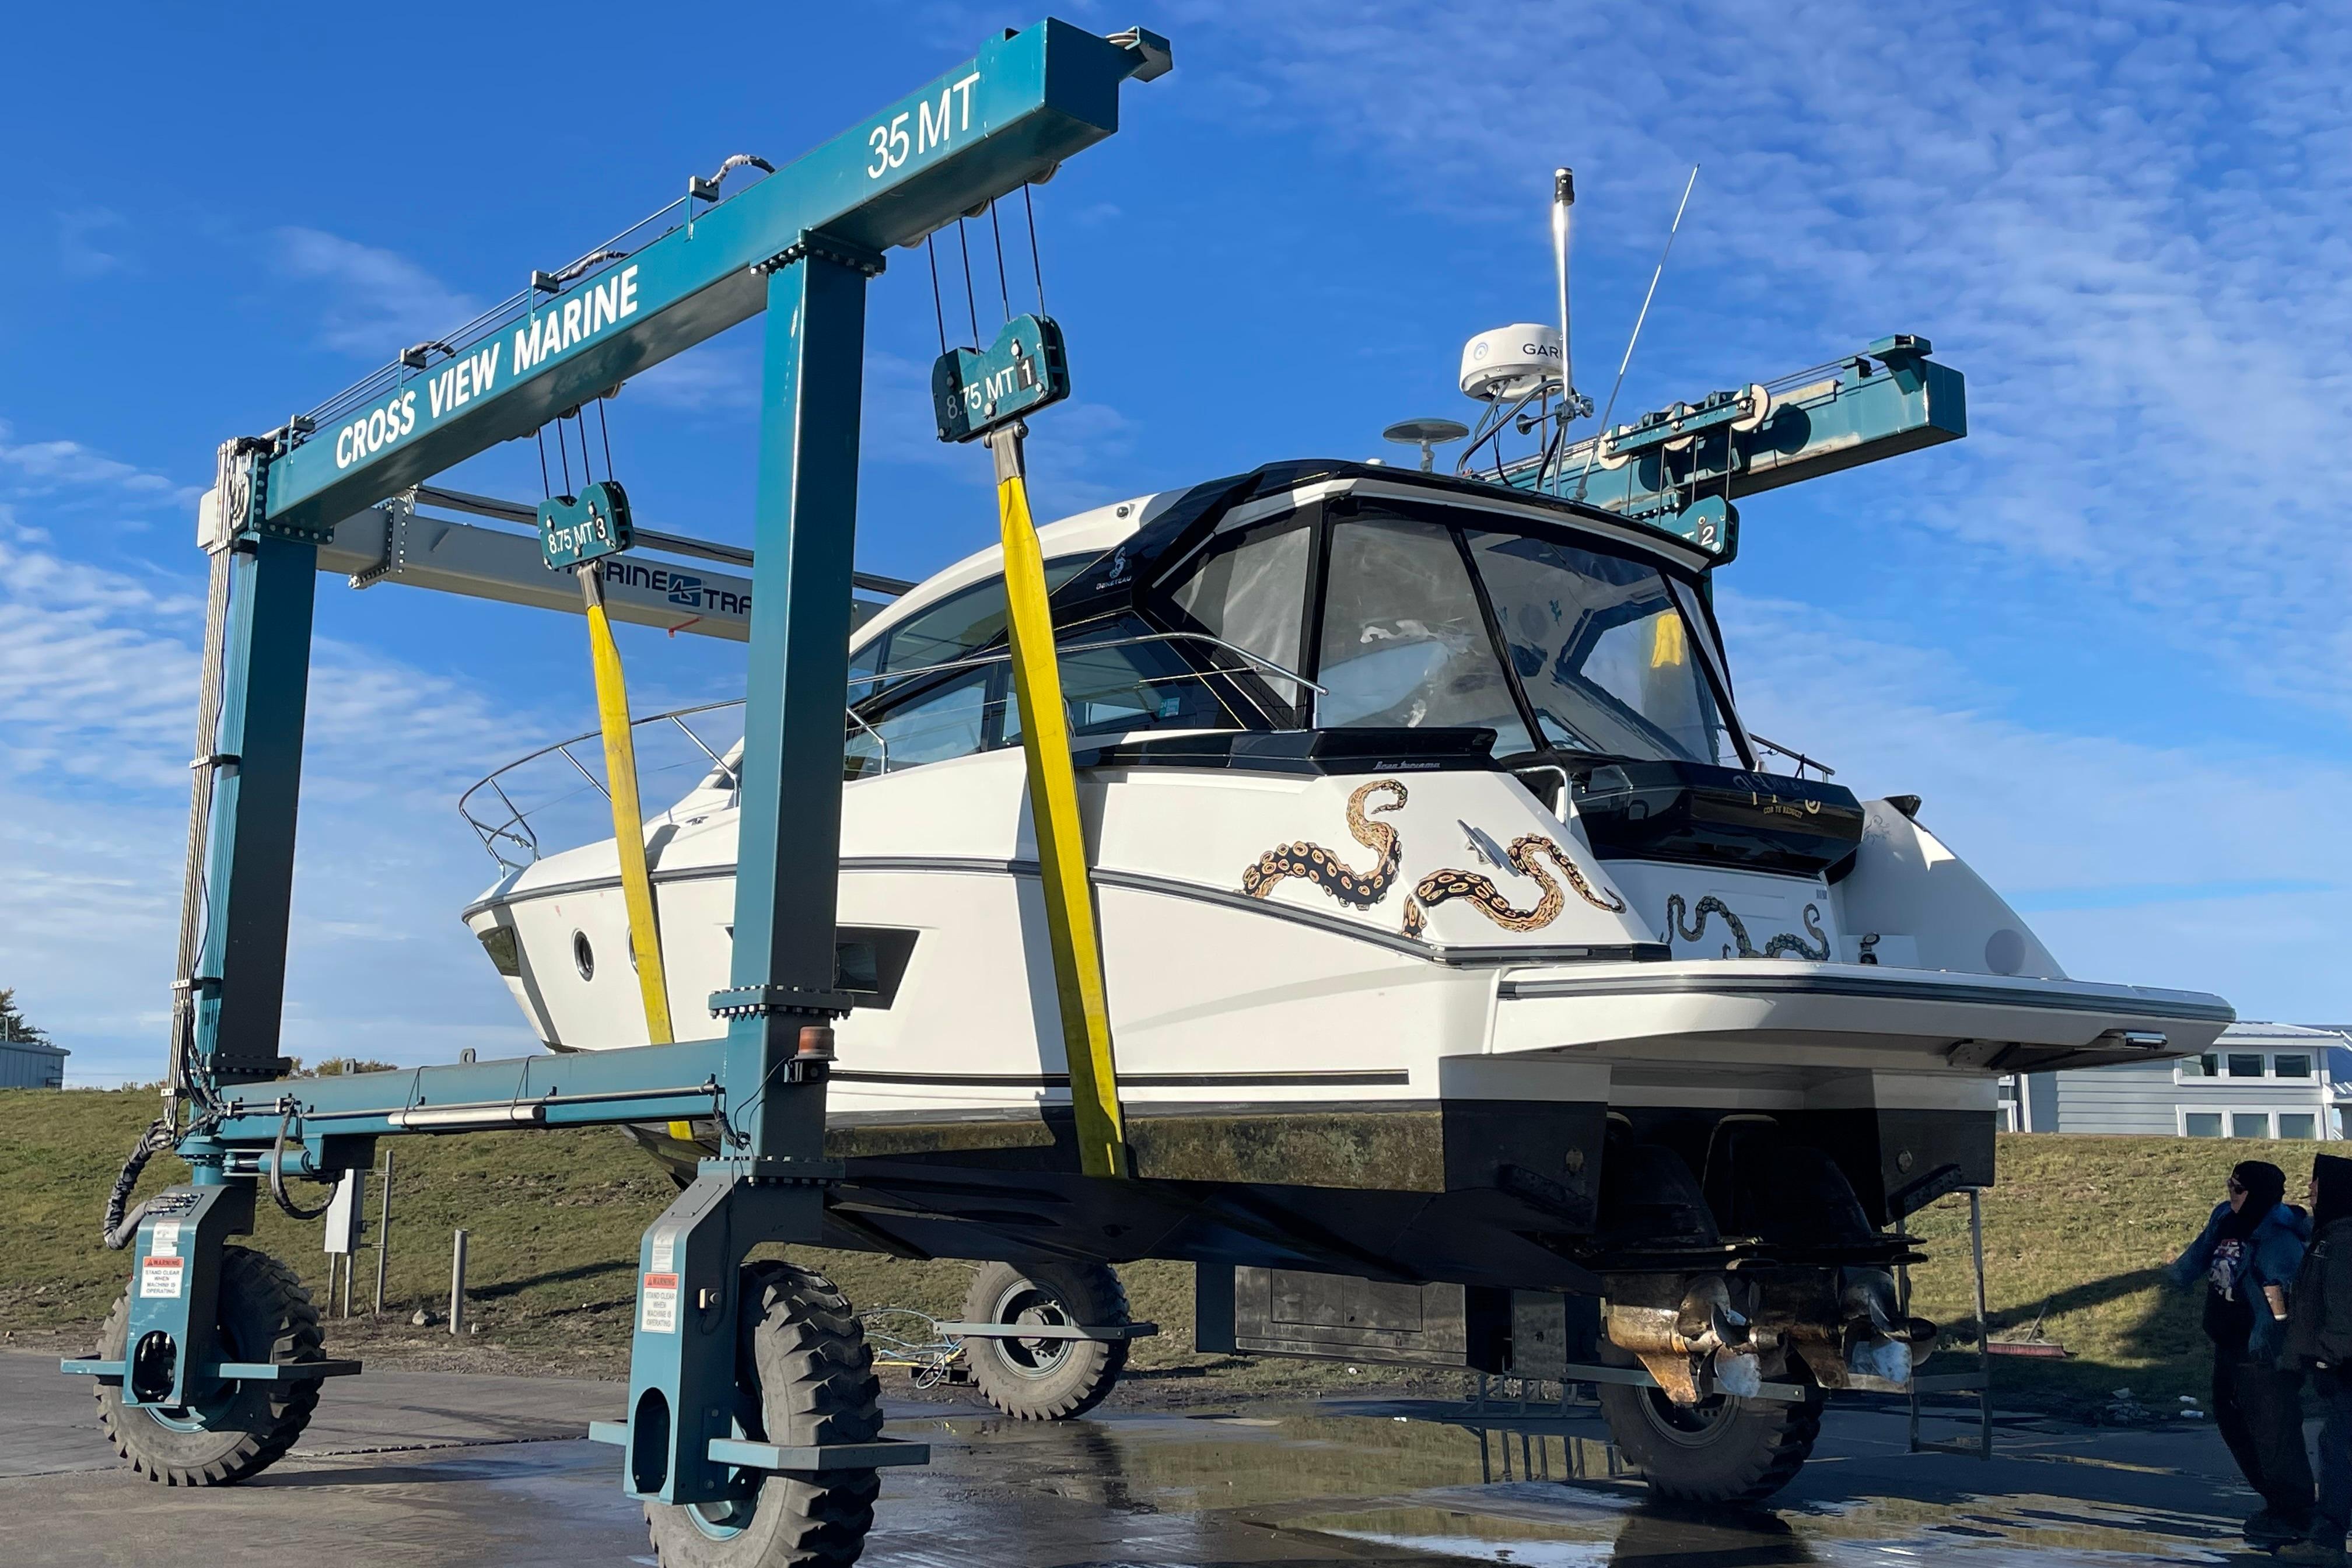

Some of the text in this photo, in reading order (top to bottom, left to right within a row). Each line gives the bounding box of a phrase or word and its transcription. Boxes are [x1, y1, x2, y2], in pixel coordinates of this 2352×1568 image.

[867, 71, 980, 179] 35 MT
[335, 264, 639, 469] CROSS VIEW MARINE
[946, 359, 1032, 419] 8.75 MT 1
[548, 517, 606, 554] 8.75 MT 3
[1700, 526, 1714, 546] 2
[603, 561, 667, 592] RINE
[653, 1277, 675, 1286] WARNING
